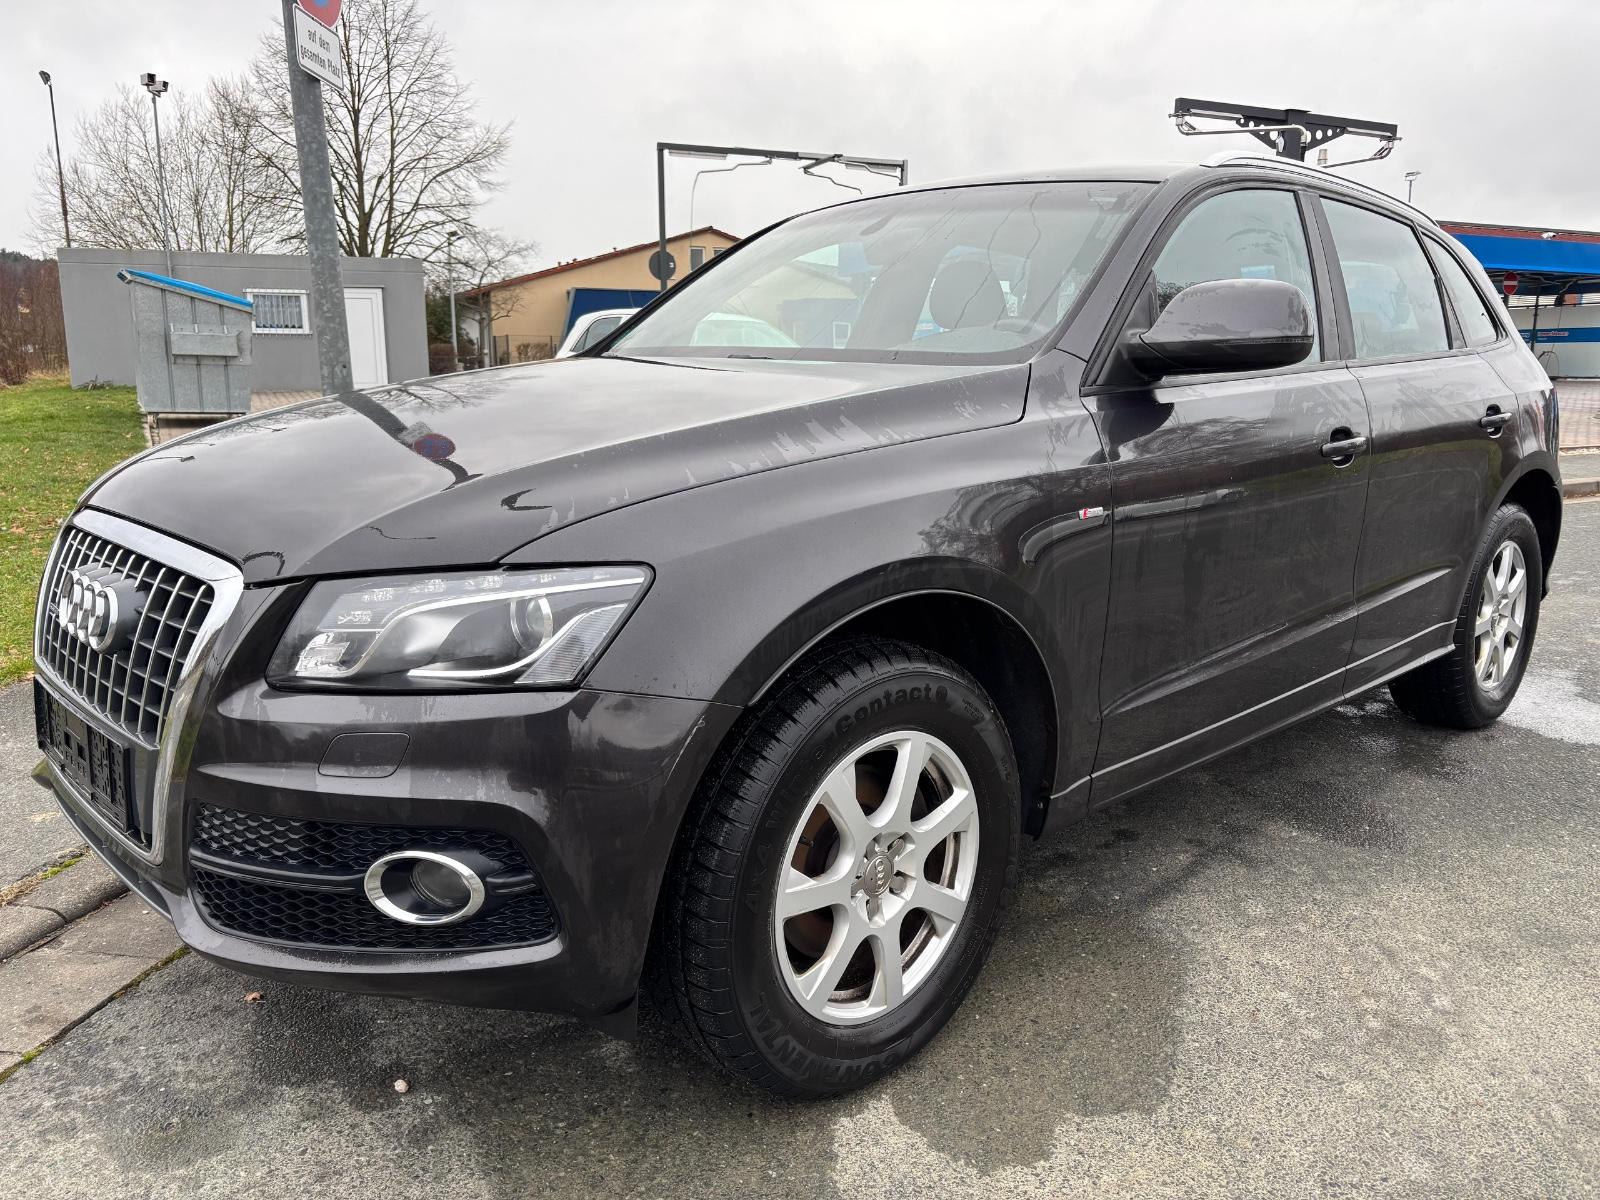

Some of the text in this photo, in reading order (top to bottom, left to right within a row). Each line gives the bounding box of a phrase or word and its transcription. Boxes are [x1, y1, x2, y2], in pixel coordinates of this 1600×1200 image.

[308, 30, 330, 52] auf dem
[300, 45, 326, 69] gesamten
